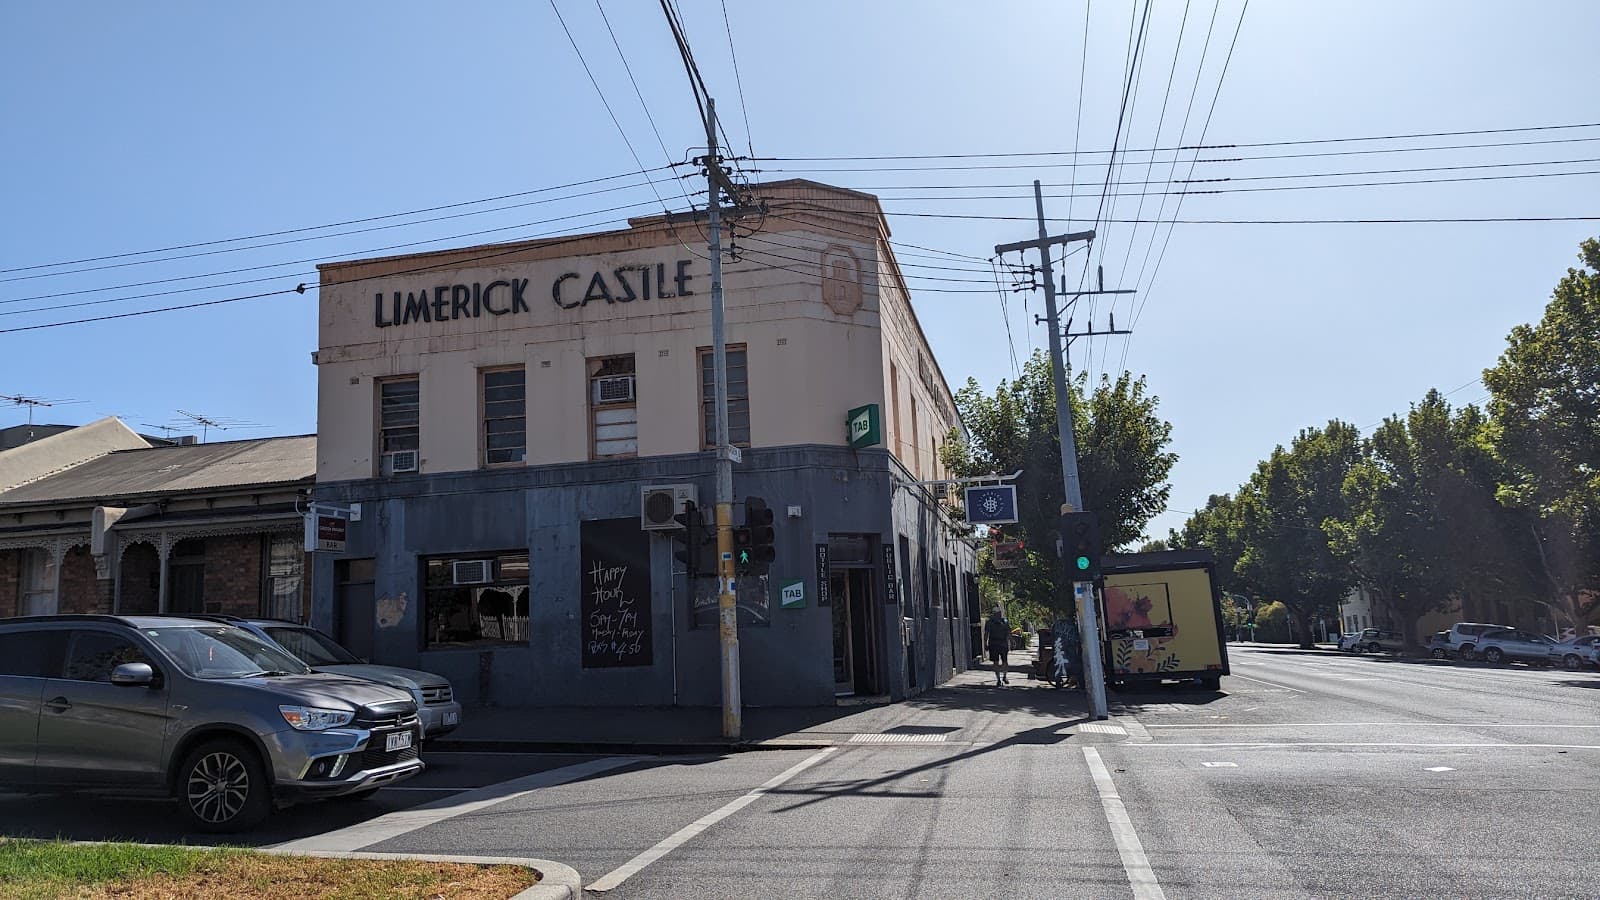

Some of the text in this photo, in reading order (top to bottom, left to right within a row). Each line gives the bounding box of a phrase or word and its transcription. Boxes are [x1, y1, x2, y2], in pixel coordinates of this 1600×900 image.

[375, 259, 693, 328] LIMERICK CASTLE
[853, 420, 868, 433] TAB
[885, 547, 895, 600] PUBLIC BAR
[784, 589, 802, 598] TAB
[820, 580, 828, 602] SHOP
